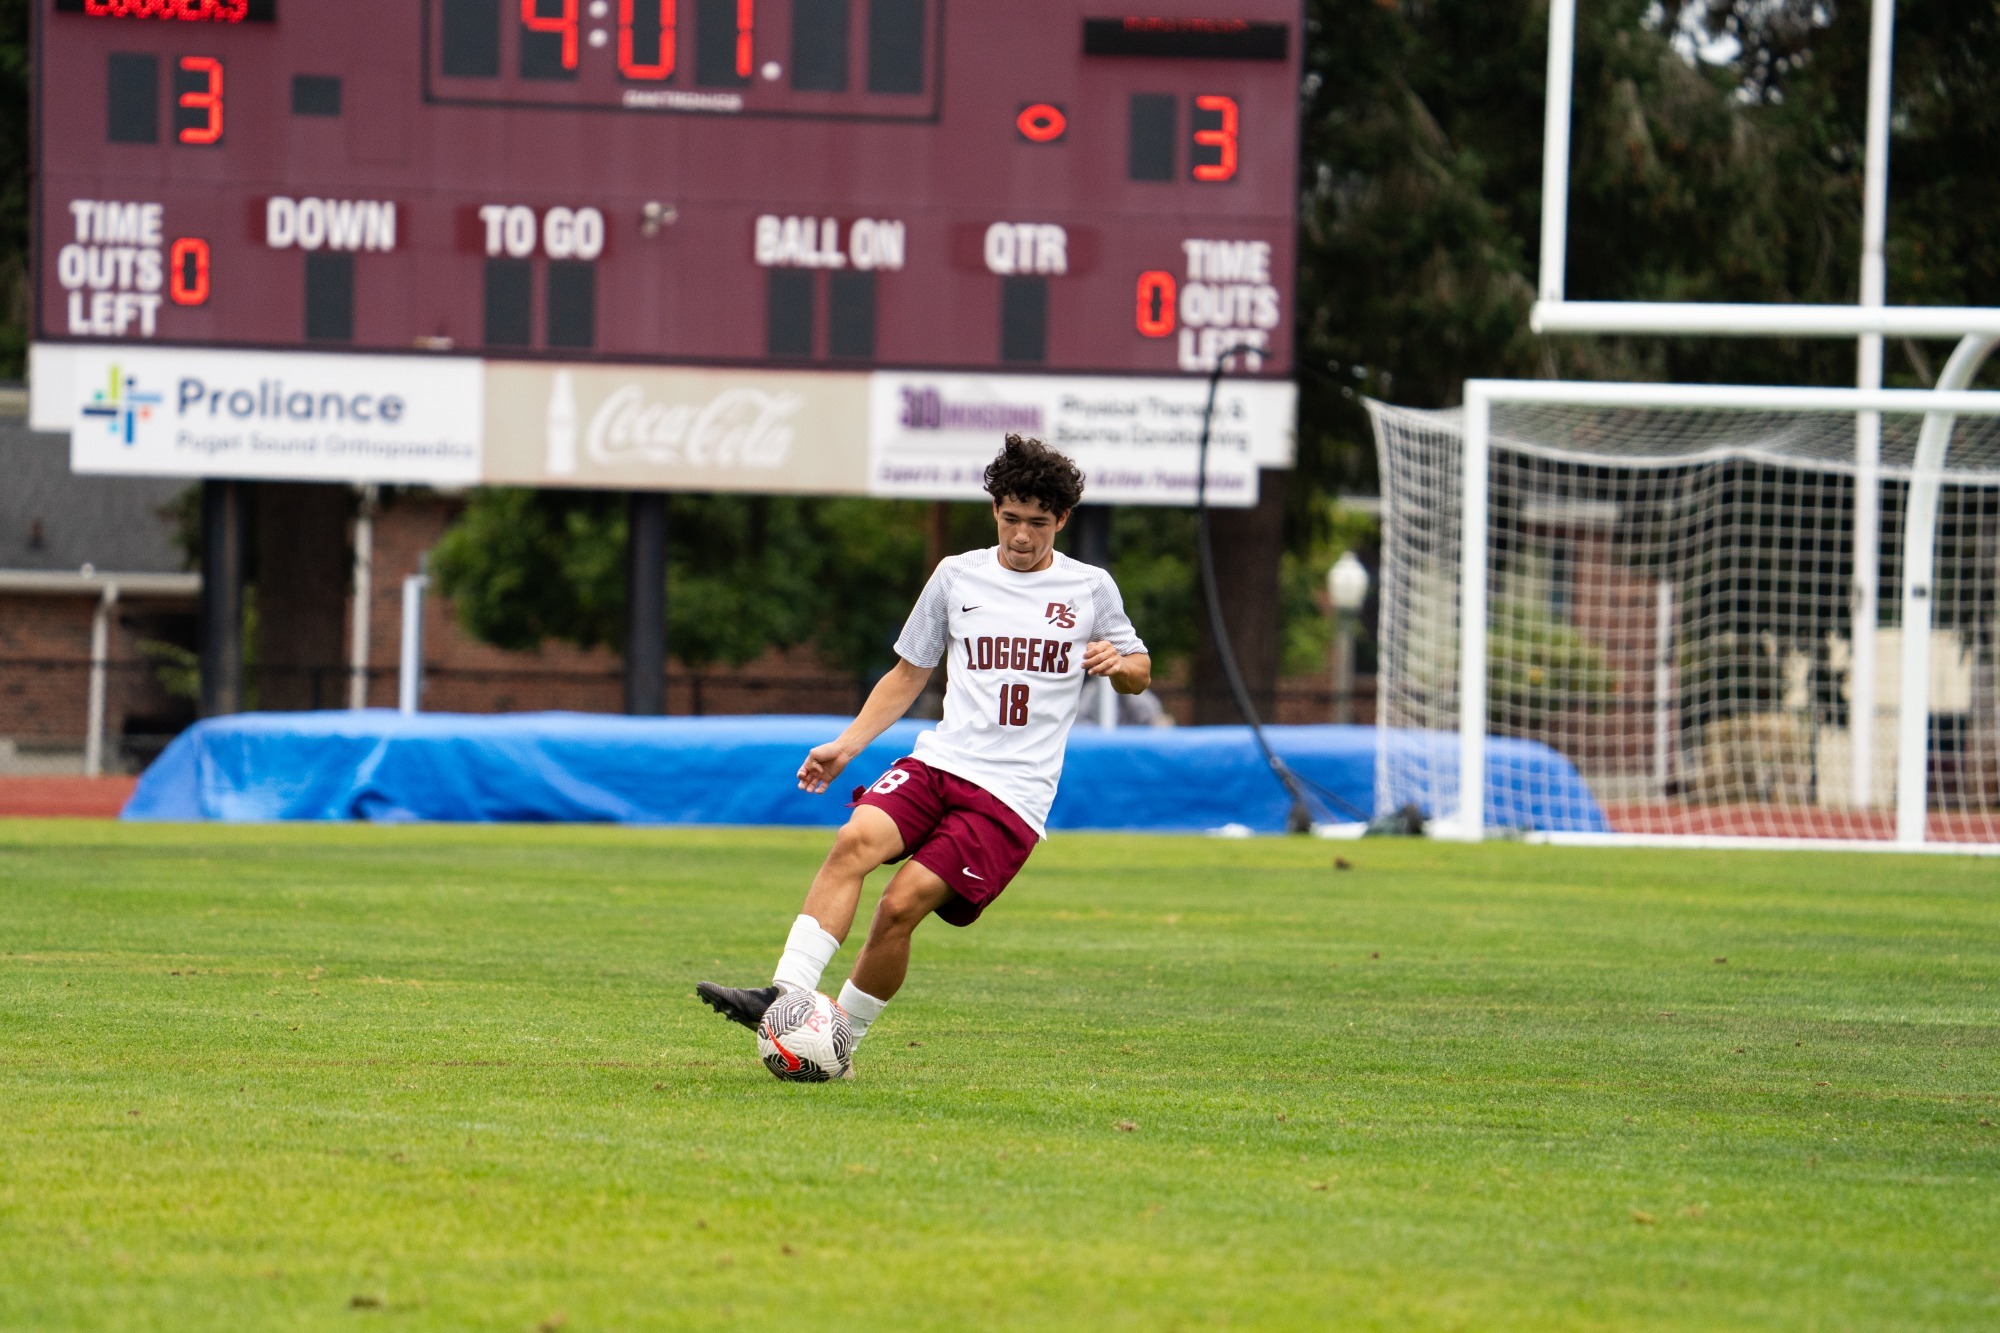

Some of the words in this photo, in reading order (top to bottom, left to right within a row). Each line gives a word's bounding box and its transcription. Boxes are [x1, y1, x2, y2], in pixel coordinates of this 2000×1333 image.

[180, 57, 223, 143] 3
[1194, 94, 1238, 181] 3
[69, 200, 163, 245] TIME
[267, 197, 396, 251] DOWN
[479, 206, 537, 257] TO
[543, 207, 604, 259] GO
[755, 215, 846, 267] BALL
[849, 218, 905, 270] ON
[58, 246, 163, 291] OUTS
[170, 237, 209, 305] 0
[984, 222, 1067, 274] QTR
[1182, 238, 1272, 282] TIME
[68, 292, 162, 336] LEFT
[1136, 271, 1176, 337] 0
[1179, 282, 1280, 328] OUTS
[1177, 328, 1269, 372] LEFT
[176, 378, 406, 424] Proliance
[963, 636, 1073, 674] LOGGERS
[998, 683, 1030, 727] 18
